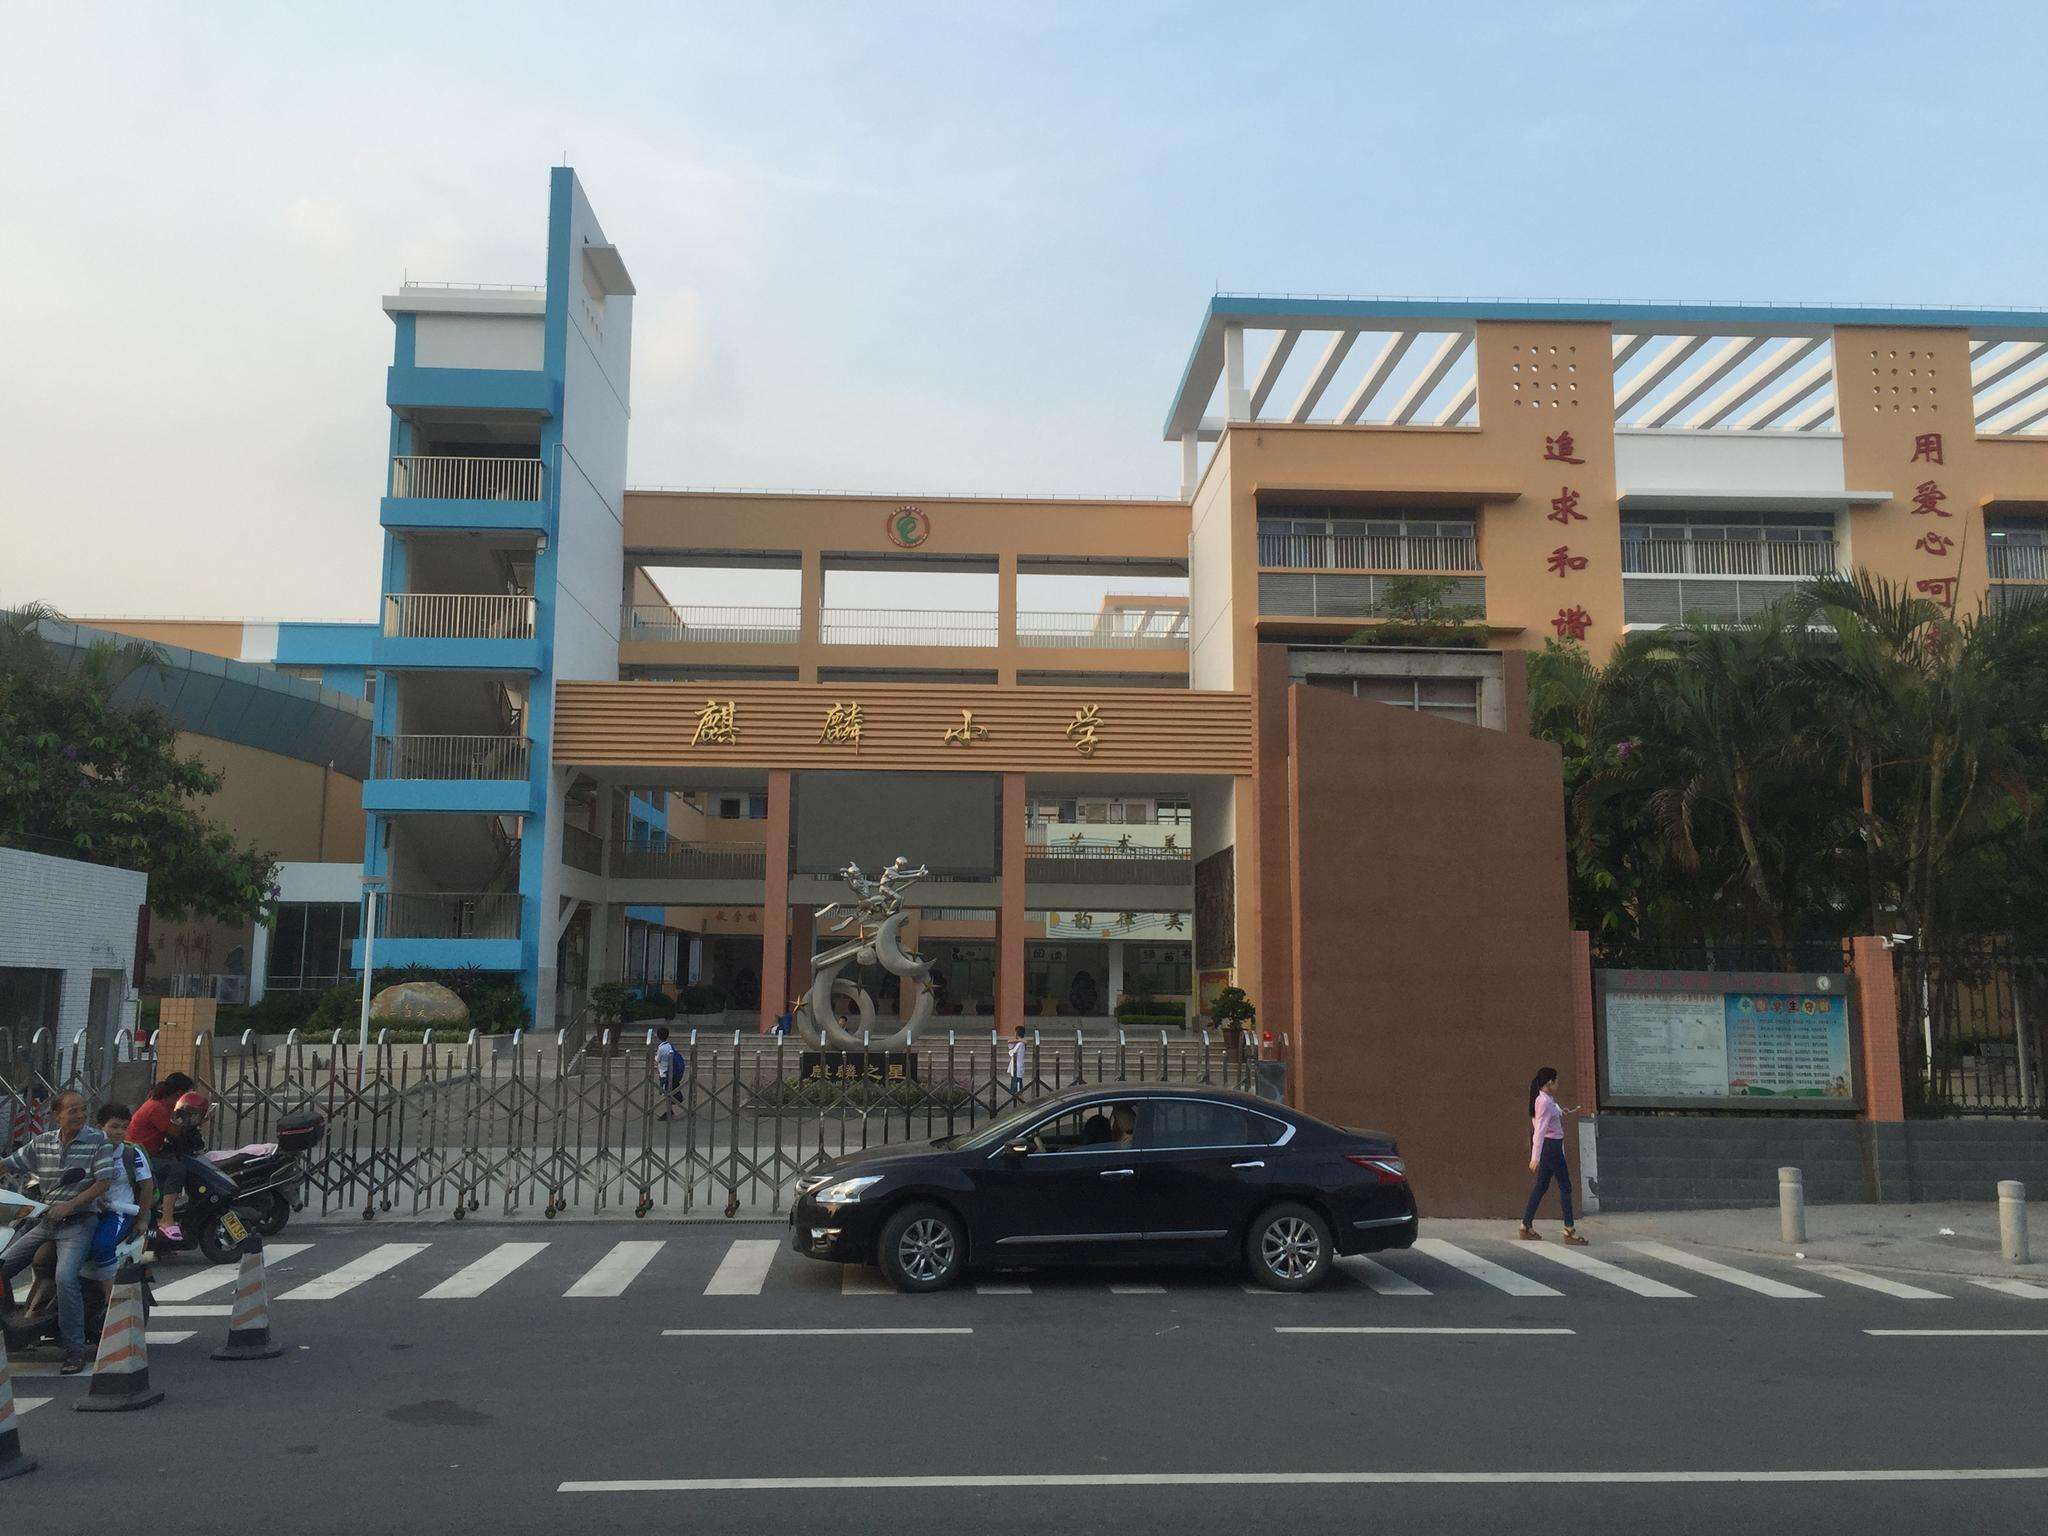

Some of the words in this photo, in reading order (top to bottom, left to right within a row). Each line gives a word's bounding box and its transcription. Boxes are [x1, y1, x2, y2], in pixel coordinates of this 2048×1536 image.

[1543, 430, 1593, 641] 追求和谐
[690, 699, 1105, 758] 麒麟小学
[809, 1064, 906, 1080] 麒麟之星
